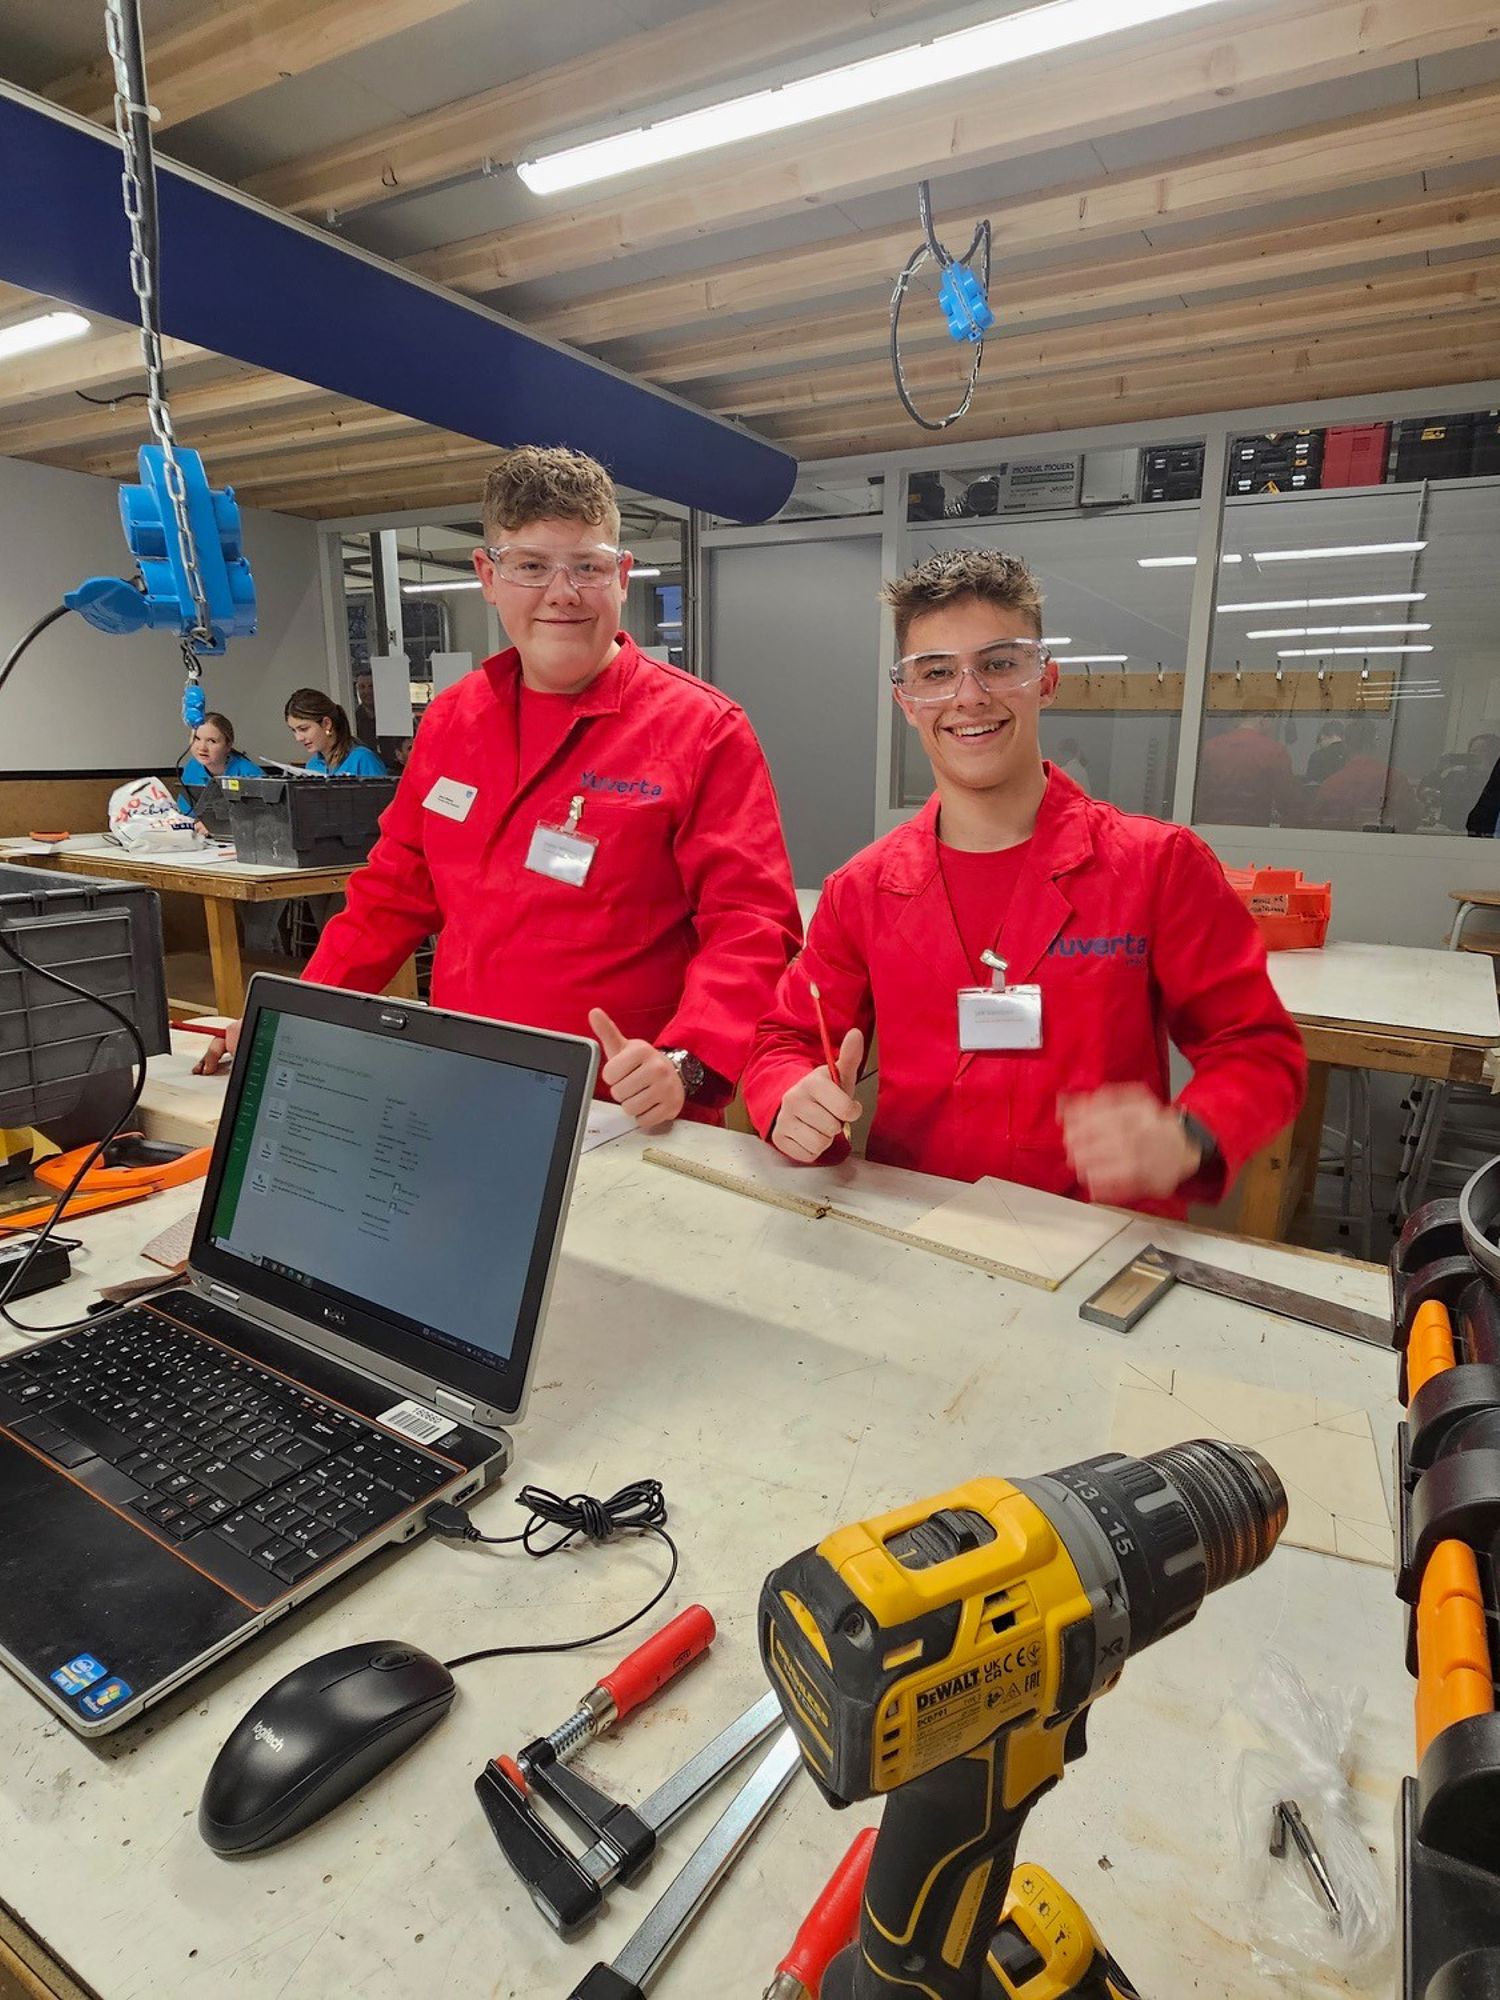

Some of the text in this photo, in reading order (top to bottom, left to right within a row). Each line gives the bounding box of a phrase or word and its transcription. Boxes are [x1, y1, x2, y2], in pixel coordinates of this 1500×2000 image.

[582, 770, 663, 796] Yuverta
[1073, 1479, 1100, 1501] 13
[1109, 1521, 1135, 1556] 15
[984, 1659, 1001, 1674] UK
[252, 1720, 284, 1752] logitech
